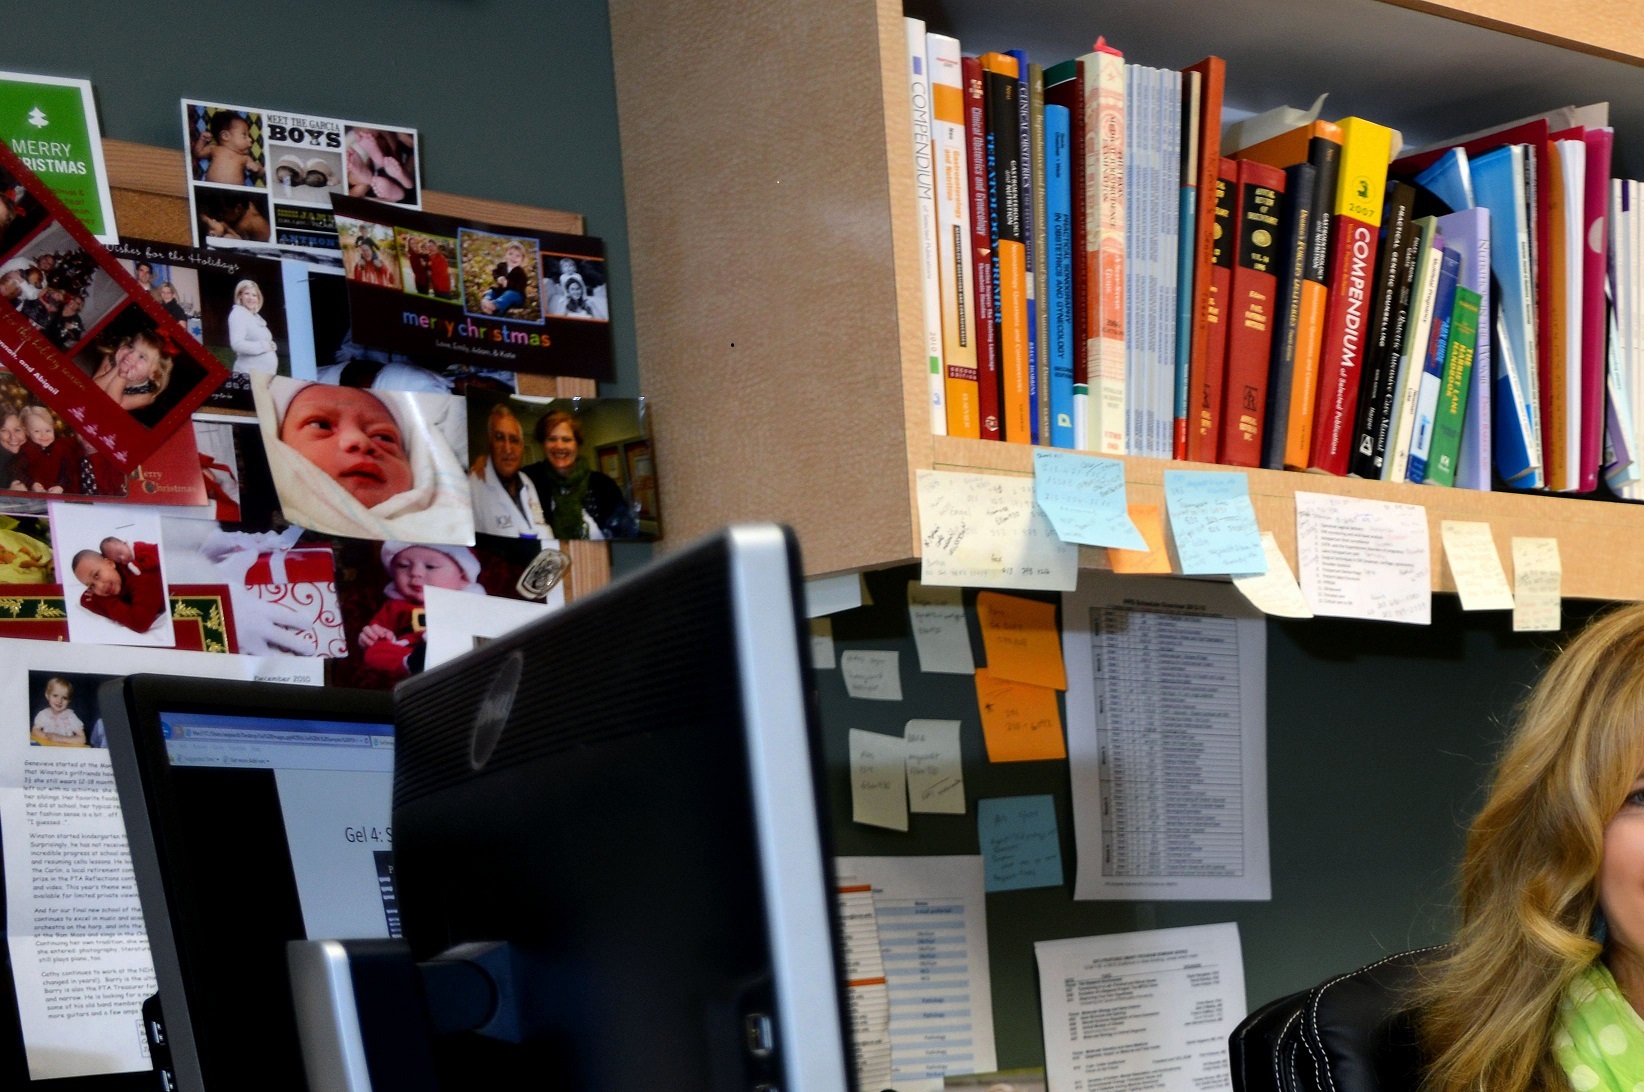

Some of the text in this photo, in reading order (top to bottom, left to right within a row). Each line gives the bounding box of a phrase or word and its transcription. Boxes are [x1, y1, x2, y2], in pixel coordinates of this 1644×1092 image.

[267, 114, 340, 132] MEET THE GARCIA
[268, 124, 341, 148] BOYS
[12, 140, 71, 157] MERRY
[911, 81, 932, 200] COMPENDIUM
[20, 157, 86, 174] RISTMAS
[971, 106, 986, 236] Clinical Obstetrics and Gynecology
[1350, 203, 1375, 218] 2007
[1338, 226, 1372, 368] COMPENDIUM
[1446, 341, 1459, 397] HANDBOOK
[1453, 343, 1466, 387] HARRIET
[1464, 348, 1473, 366] THE
[19, 356, 34, 373] and
[33, 371, 60, 396] Abigail
[1335, 377, 1347, 410] Selected
[1449, 389, 1459, 414] LANE
[1329, 410, 1343, 456] Publications
[345, 826, 368, 844] Gel
[370, 828, 383, 844] 4:
